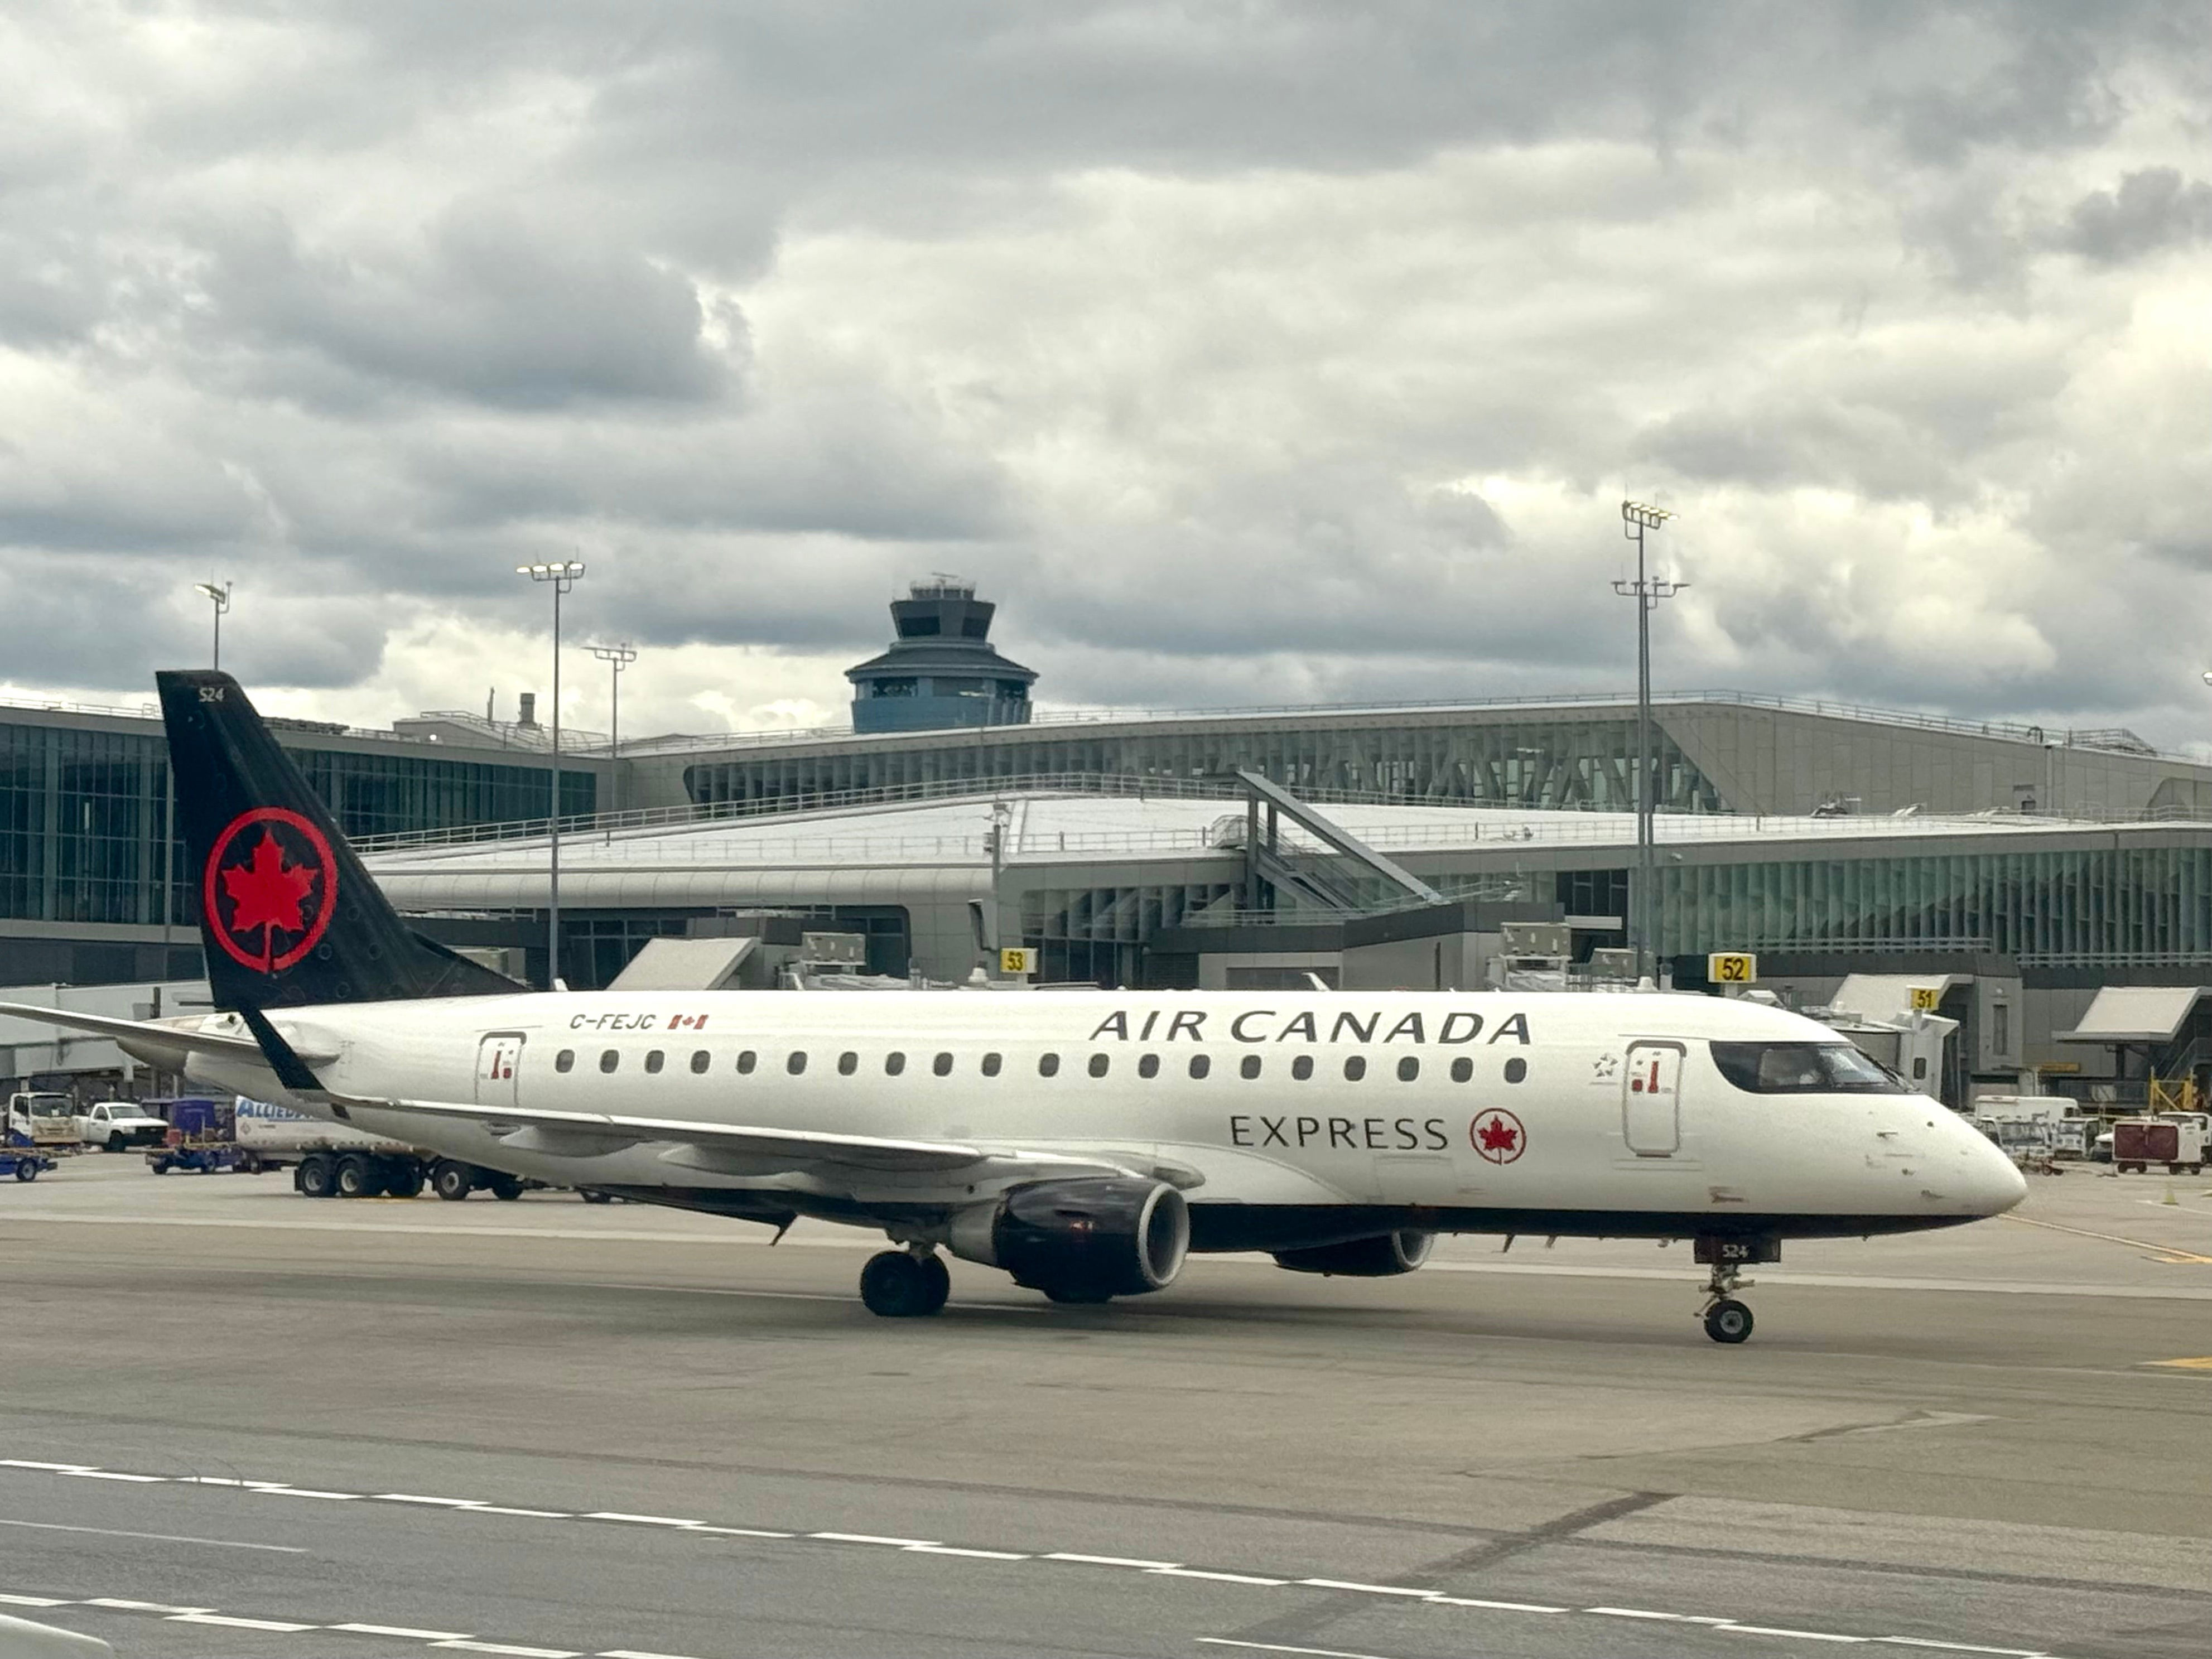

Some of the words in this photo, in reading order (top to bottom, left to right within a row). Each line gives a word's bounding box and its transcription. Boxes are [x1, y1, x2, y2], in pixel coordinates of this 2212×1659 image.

[199, 687, 224, 702] 524
[1007, 951, 1023, 971] 53
[1722, 957, 1744, 981] 52
[1917, 990, 1932, 1009] 51
[570, 1014, 657, 1030] C-FEJC
[1088, 1010, 1208, 1042] AIR
[1230, 1010, 1531, 1045] CANADA
[1230, 1116, 1449, 1151] EXPRESS
